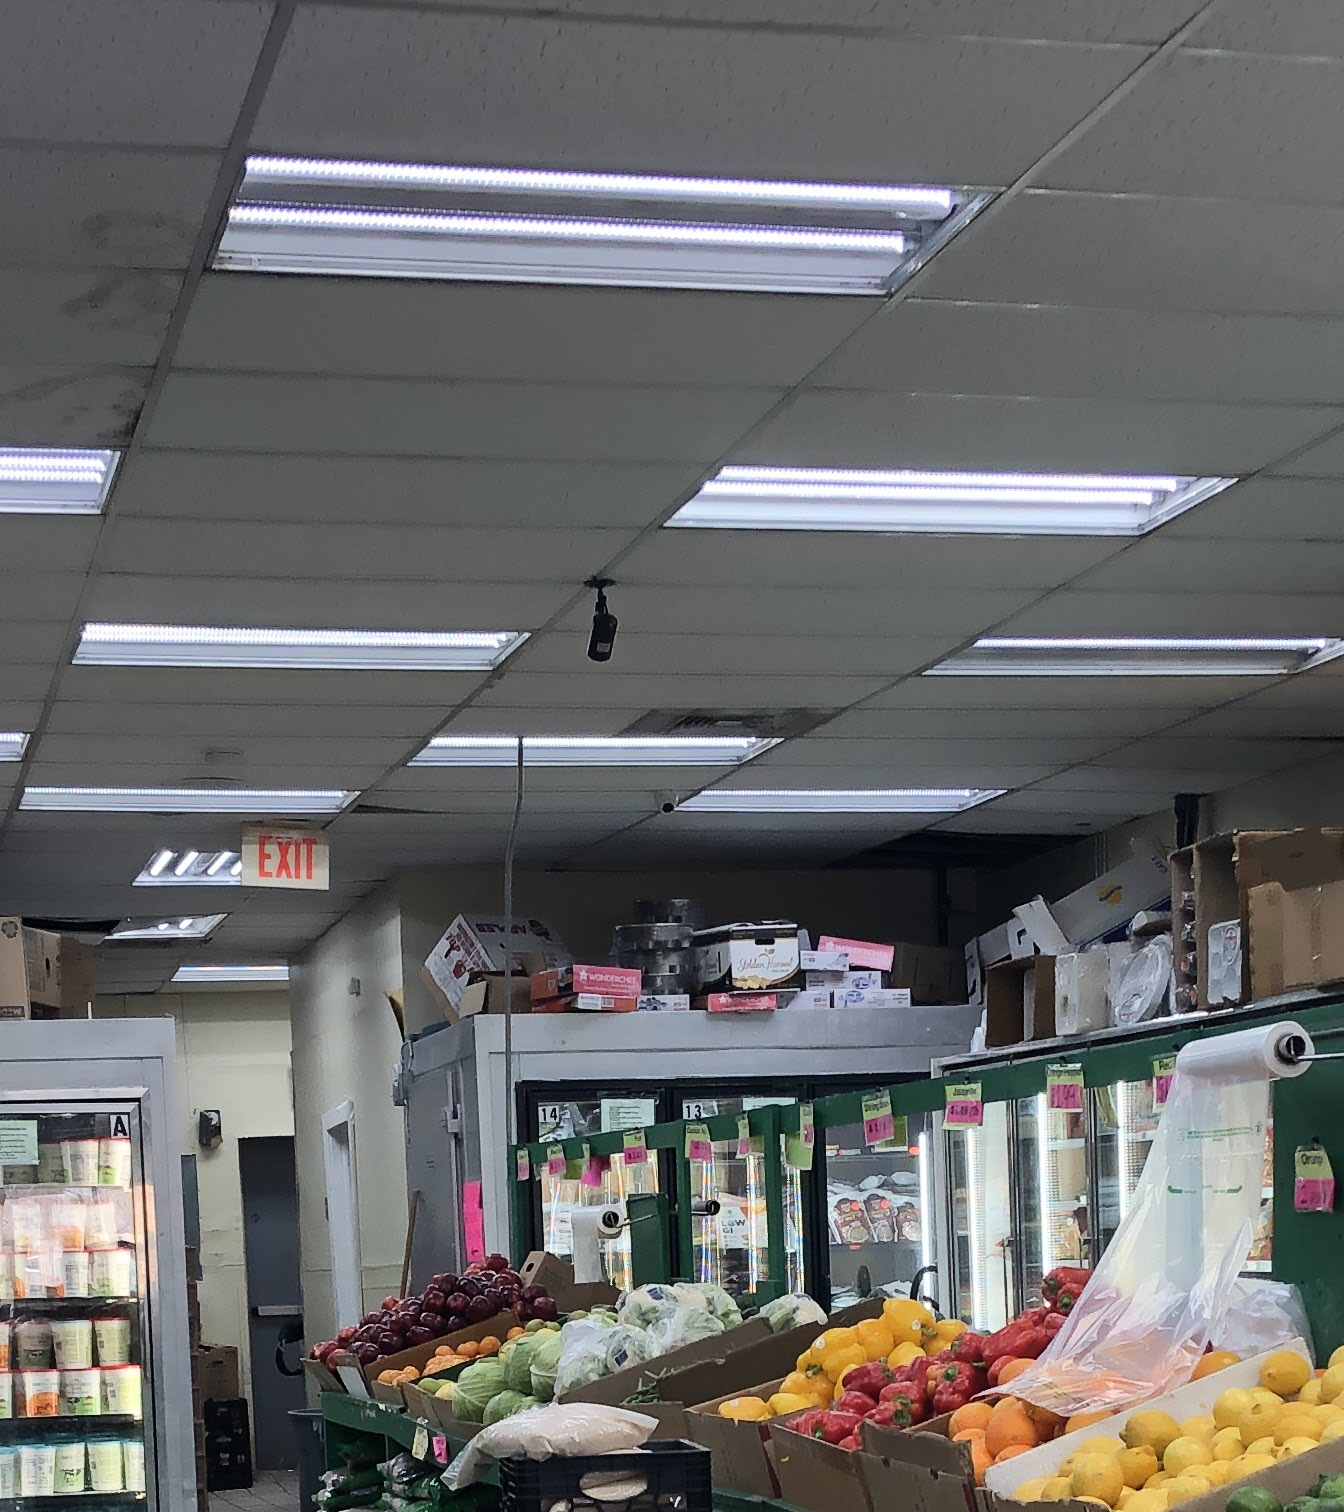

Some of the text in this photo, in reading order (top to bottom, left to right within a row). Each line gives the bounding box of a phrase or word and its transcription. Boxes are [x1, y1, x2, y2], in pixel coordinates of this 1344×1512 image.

[258, 835, 318, 880] EXIT
[540, 1107, 559, 1122] 14
[684, 1103, 703, 1119] 13
[113, 1116, 128, 1137] A
